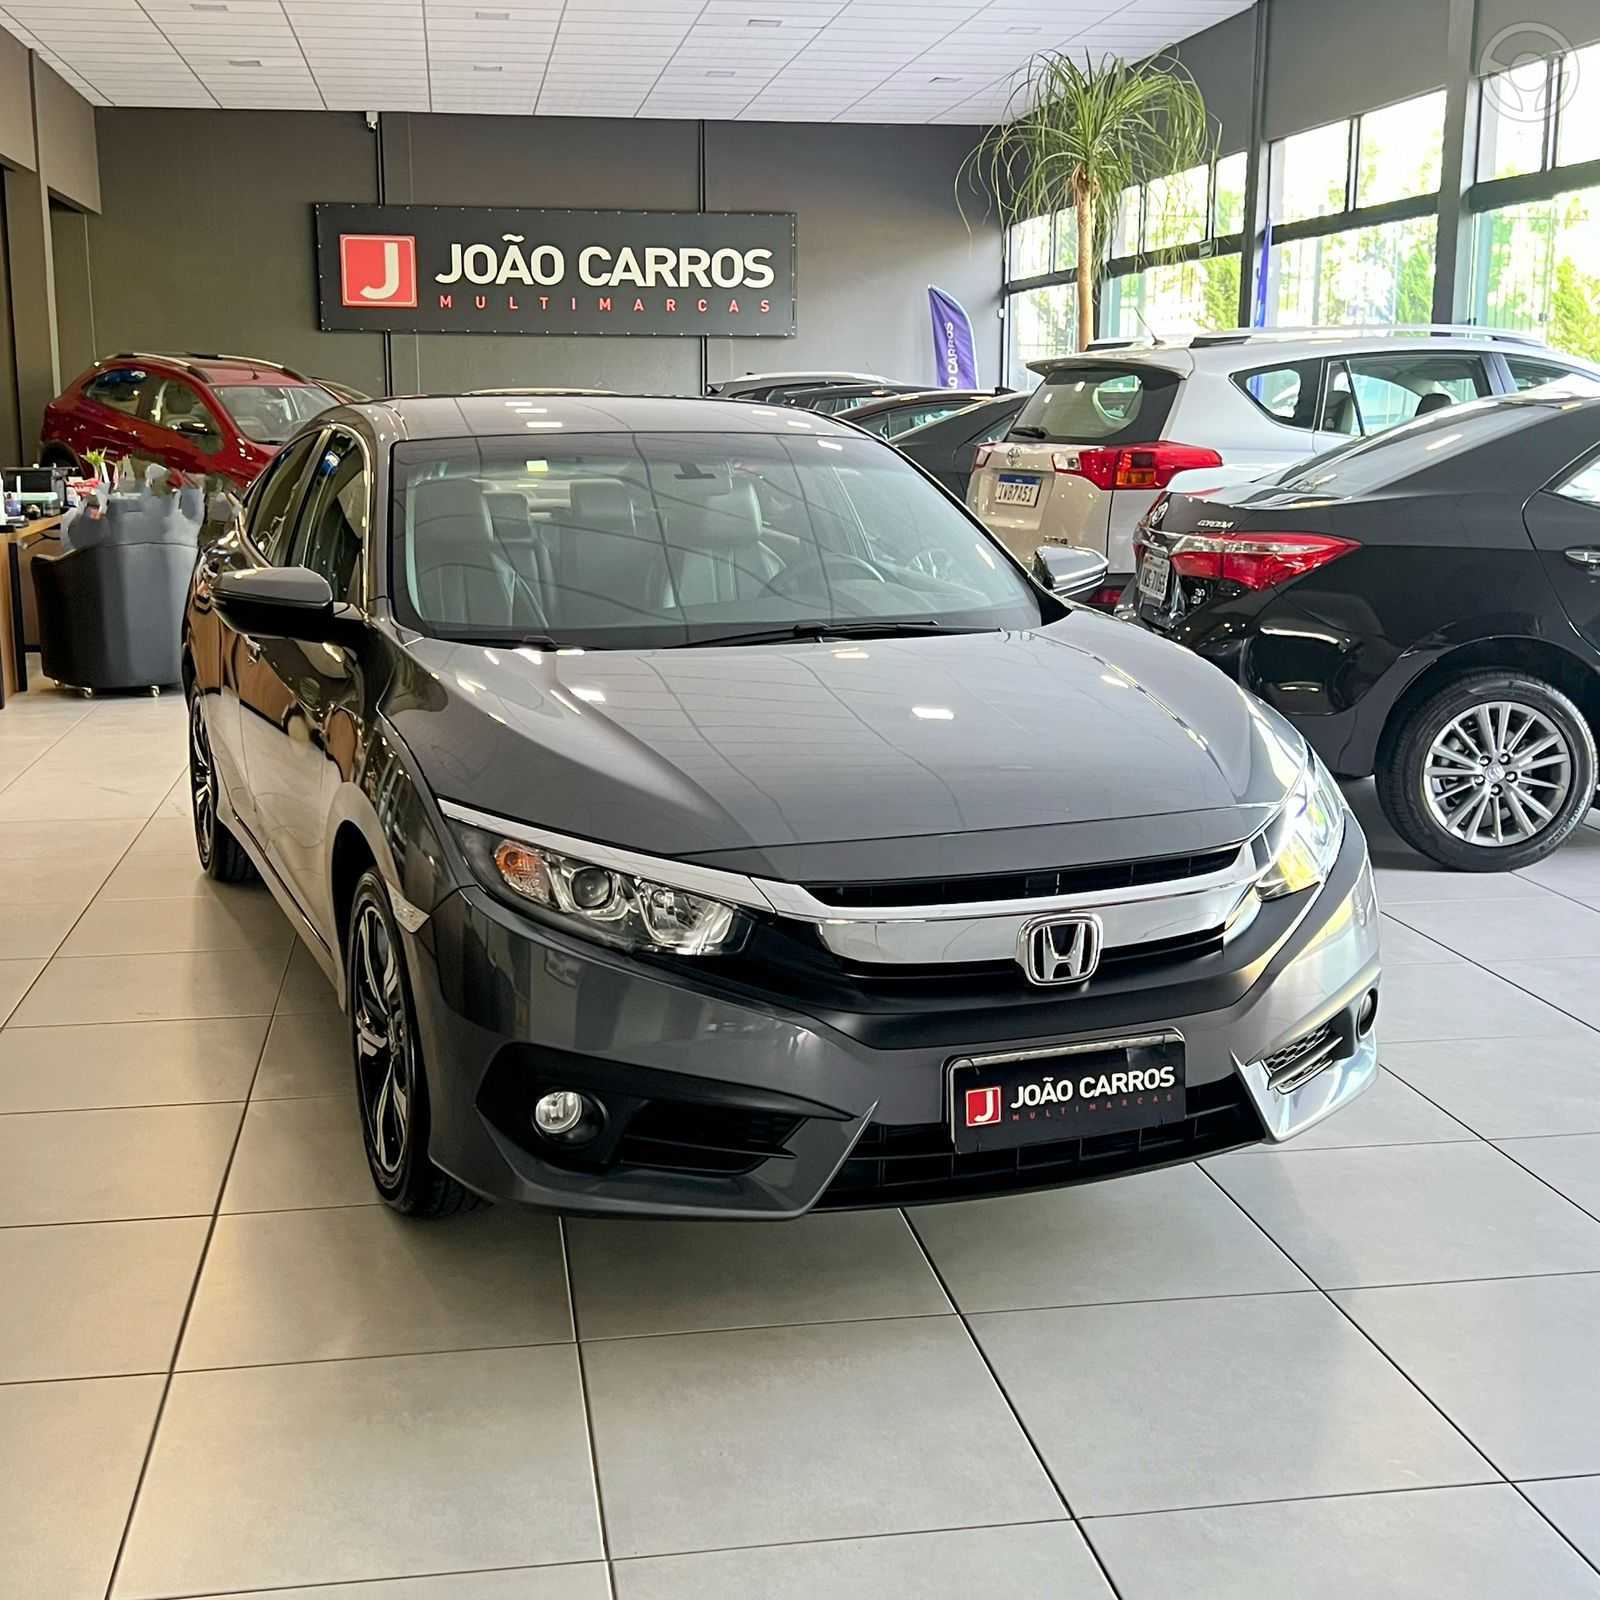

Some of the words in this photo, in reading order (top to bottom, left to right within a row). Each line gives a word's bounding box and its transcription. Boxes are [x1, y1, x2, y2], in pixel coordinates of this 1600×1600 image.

[359, 242, 401, 300] J
[435, 233, 565, 286] JOÃO
[578, 246, 775, 289] CARROS
[439, 295, 770, 313] MULTIMARCAS
[1009, 1076, 1074, 1109] JOÃO
[1079, 1065, 1176, 1099] CARROS
[1012, 1094, 1175, 1121] MULTIMARCAS
